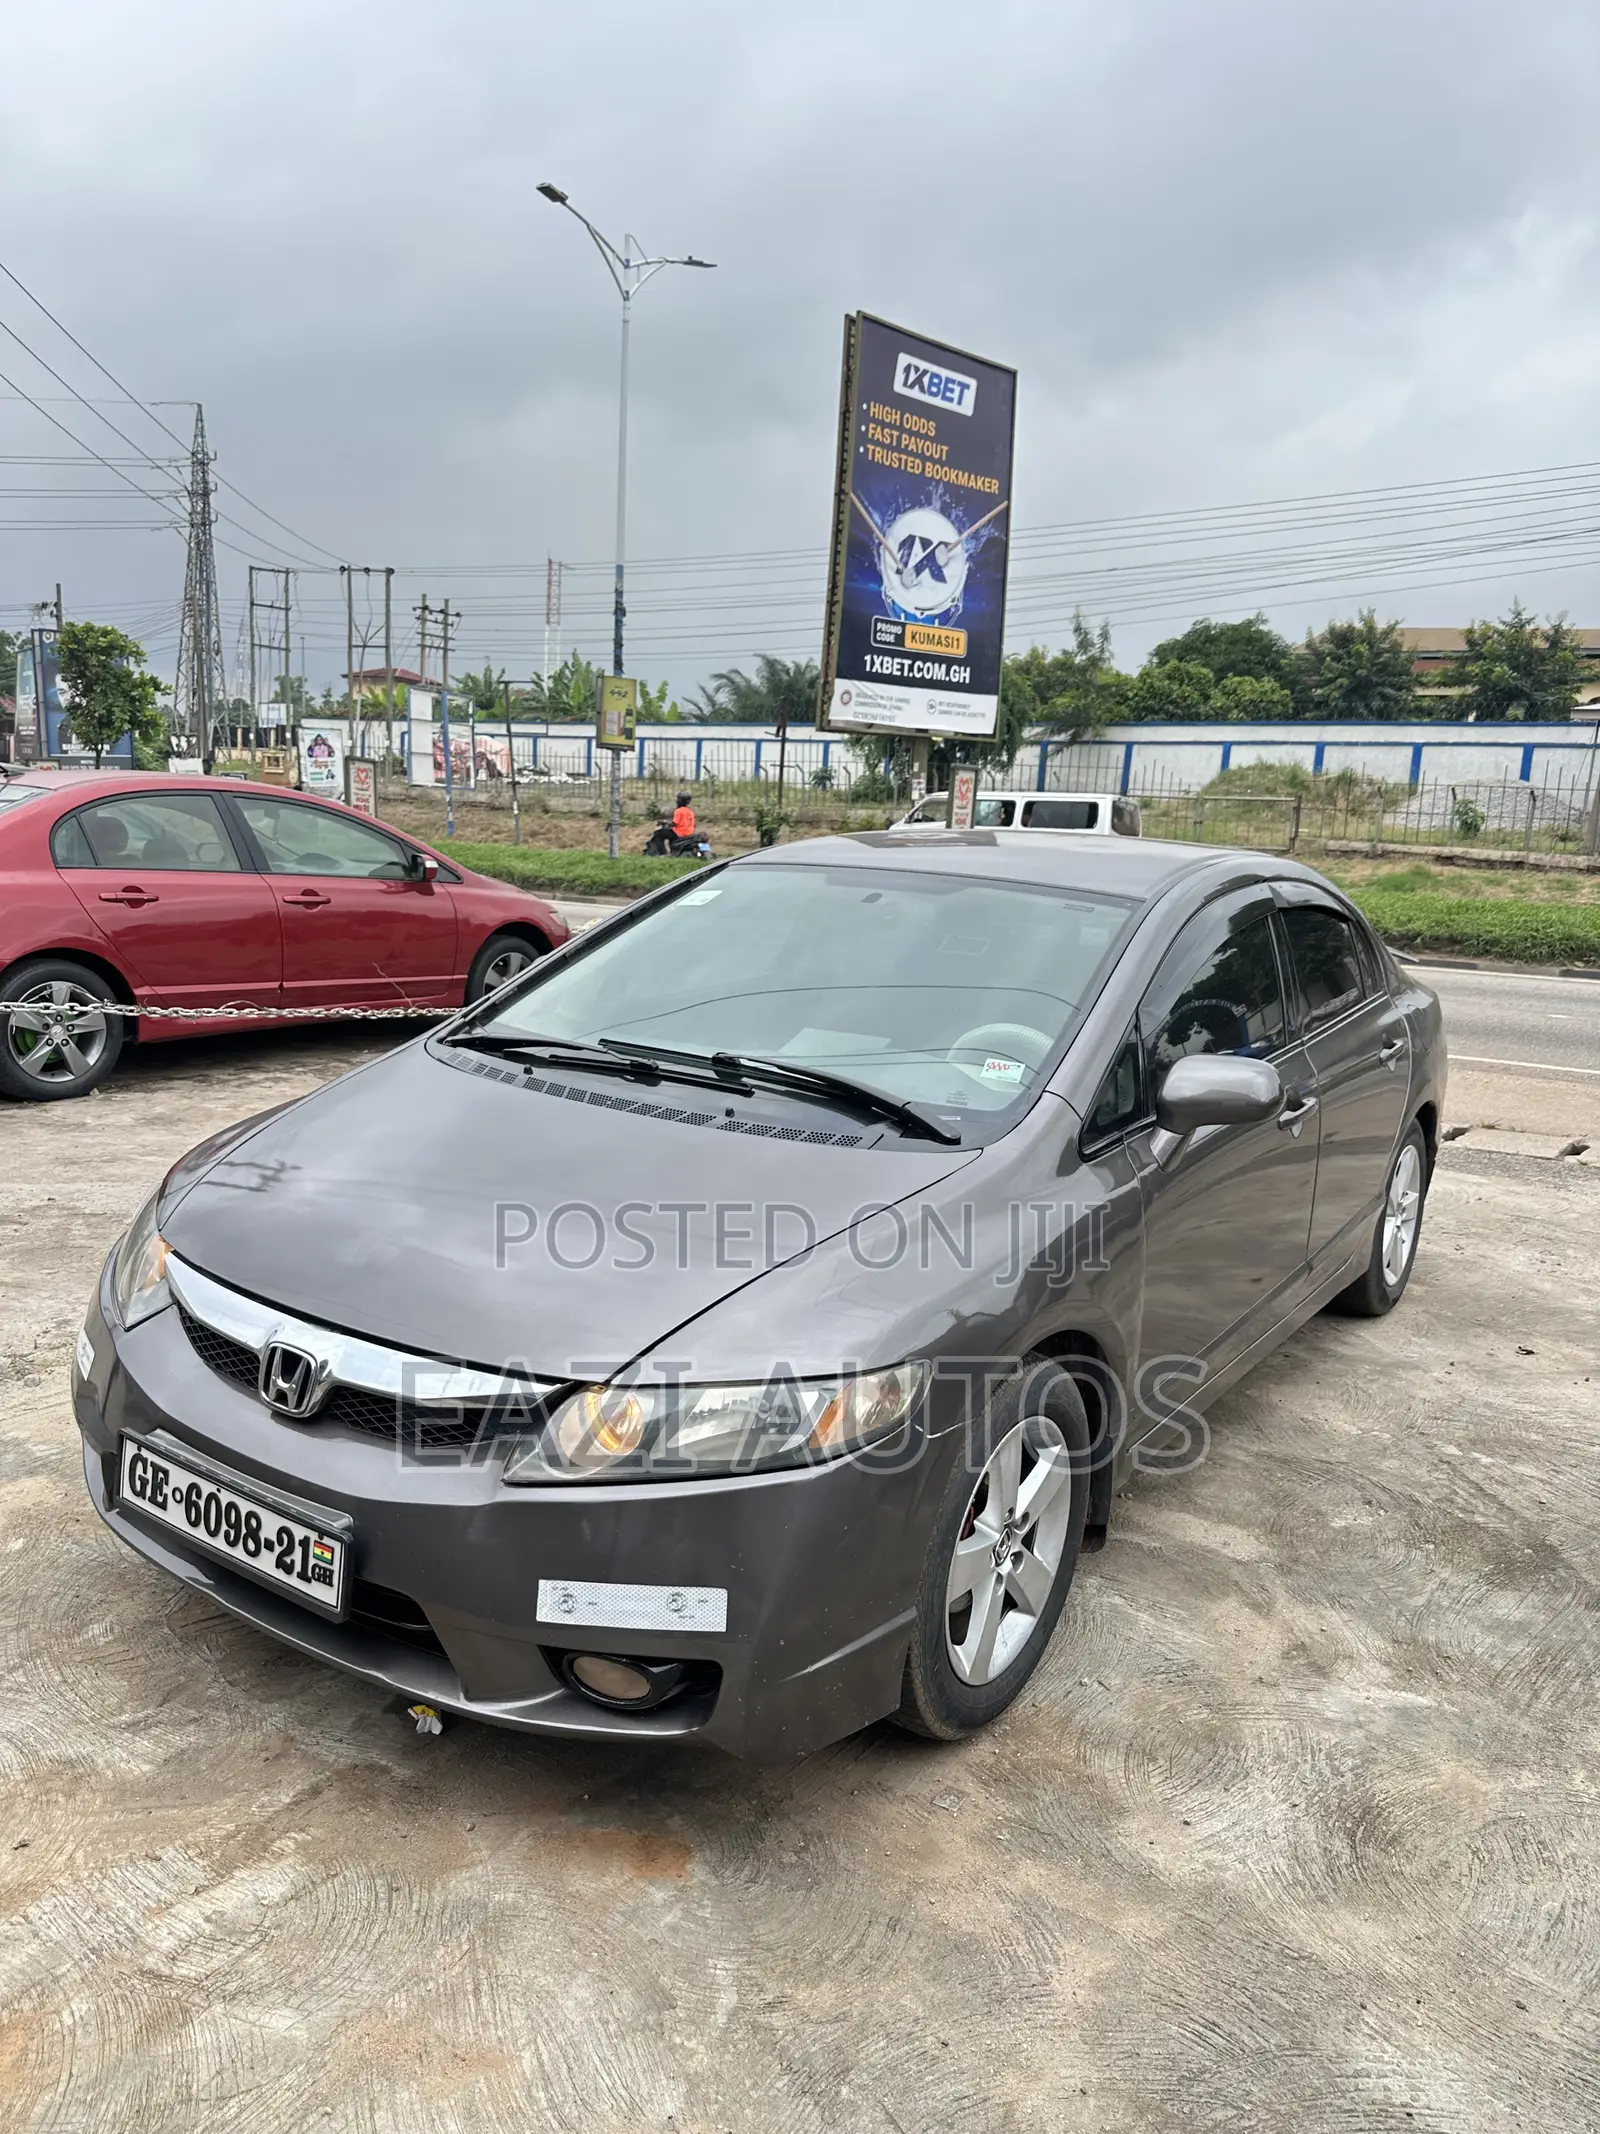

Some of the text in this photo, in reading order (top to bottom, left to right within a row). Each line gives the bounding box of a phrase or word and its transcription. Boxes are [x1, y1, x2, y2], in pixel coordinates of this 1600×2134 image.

[902, 363, 970, 406] 1XBET
[869, 401, 936, 437] HIGH ODDS
[867, 423, 949, 461] FAST PAYOUT
[866, 444, 999, 494] TRUSTED BOOKMAKER
[876, 622, 902, 635] PROMO
[876, 632, 895, 643] CODE
[910, 630, 961, 650] KUMASI1
[864, 654, 971, 684] 1XBET.COM.GH
[310, 1563, 335, 1588] GH
